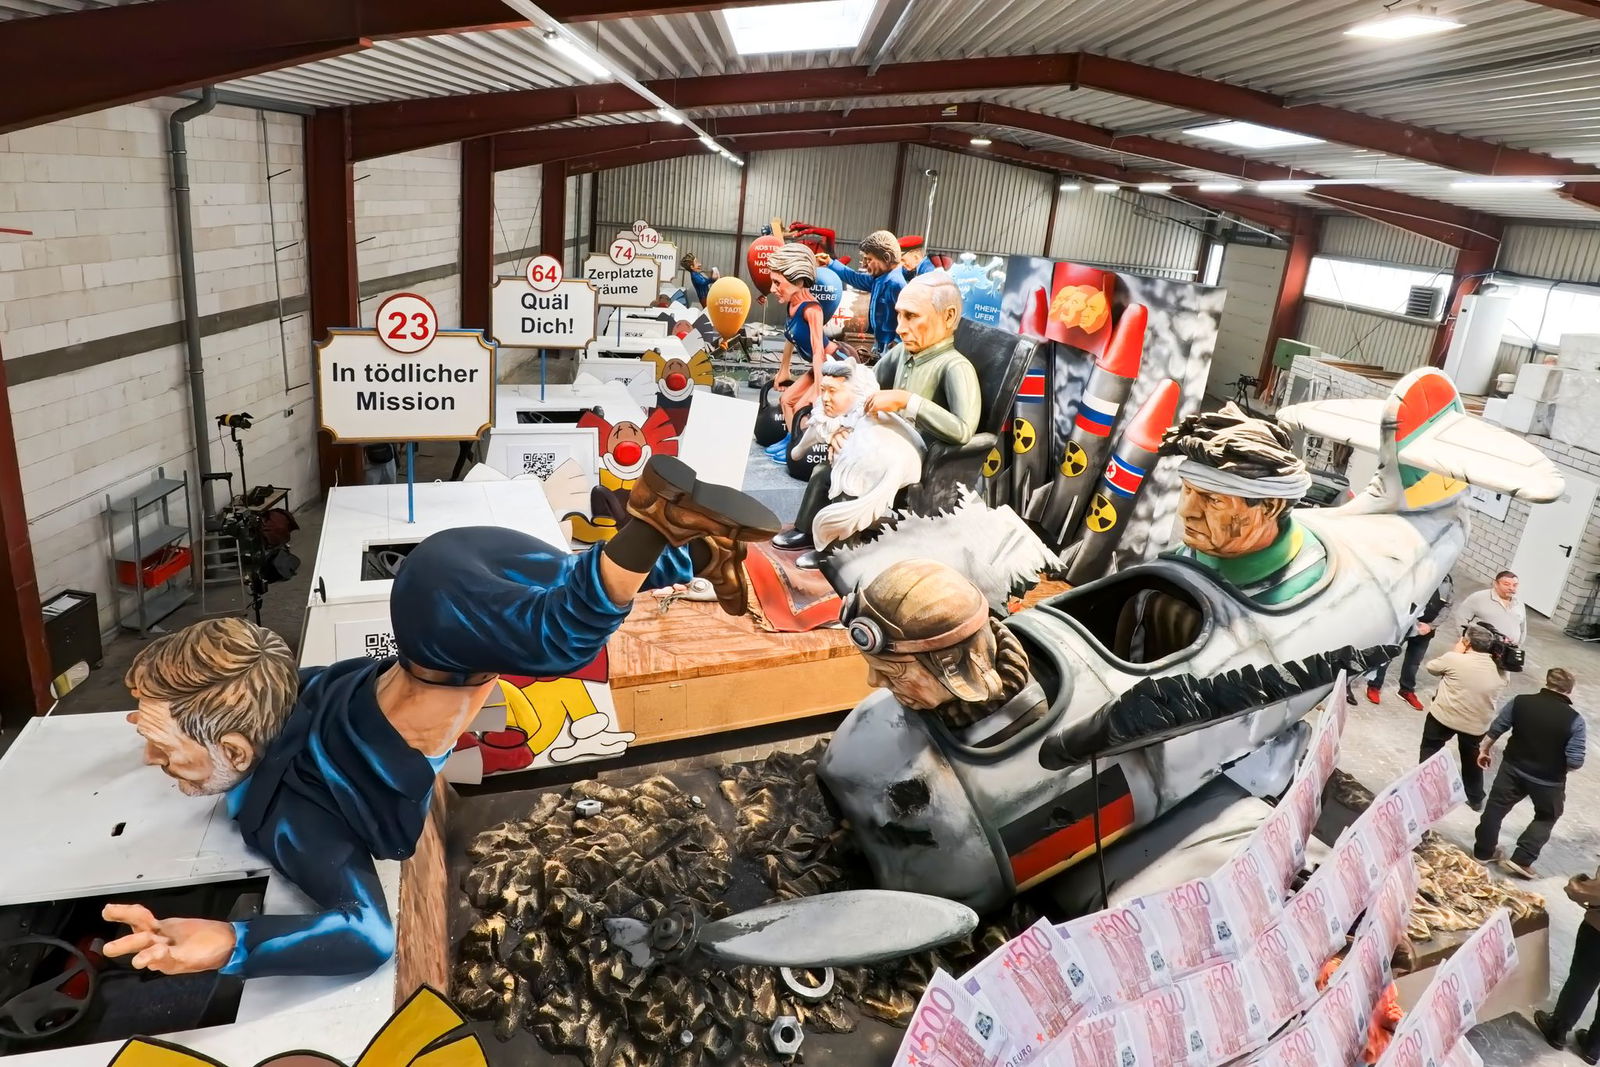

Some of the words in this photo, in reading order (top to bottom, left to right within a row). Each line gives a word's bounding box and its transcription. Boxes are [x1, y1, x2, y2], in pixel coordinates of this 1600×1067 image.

[640, 234, 657, 243] 114
[615, 246, 632, 260] 74
[532, 265, 557, 283] 64
[588, 267, 654, 281] Zerplatzte
[521, 293, 568, 310] Quäl
[388, 312, 429, 340] 23
[521, 317, 573, 334] Dich!
[332, 362, 355, 382] In
[364, 363, 478, 382] tödlicher
[356, 391, 455, 411] Mission
[1173, 881, 1211, 909] 500
[1098, 909, 1142, 939] 500
[1007, 926, 1053, 971] 500
[909, 986, 955, 1061] 500
[1012, 1044, 1032, 1065] EURO
